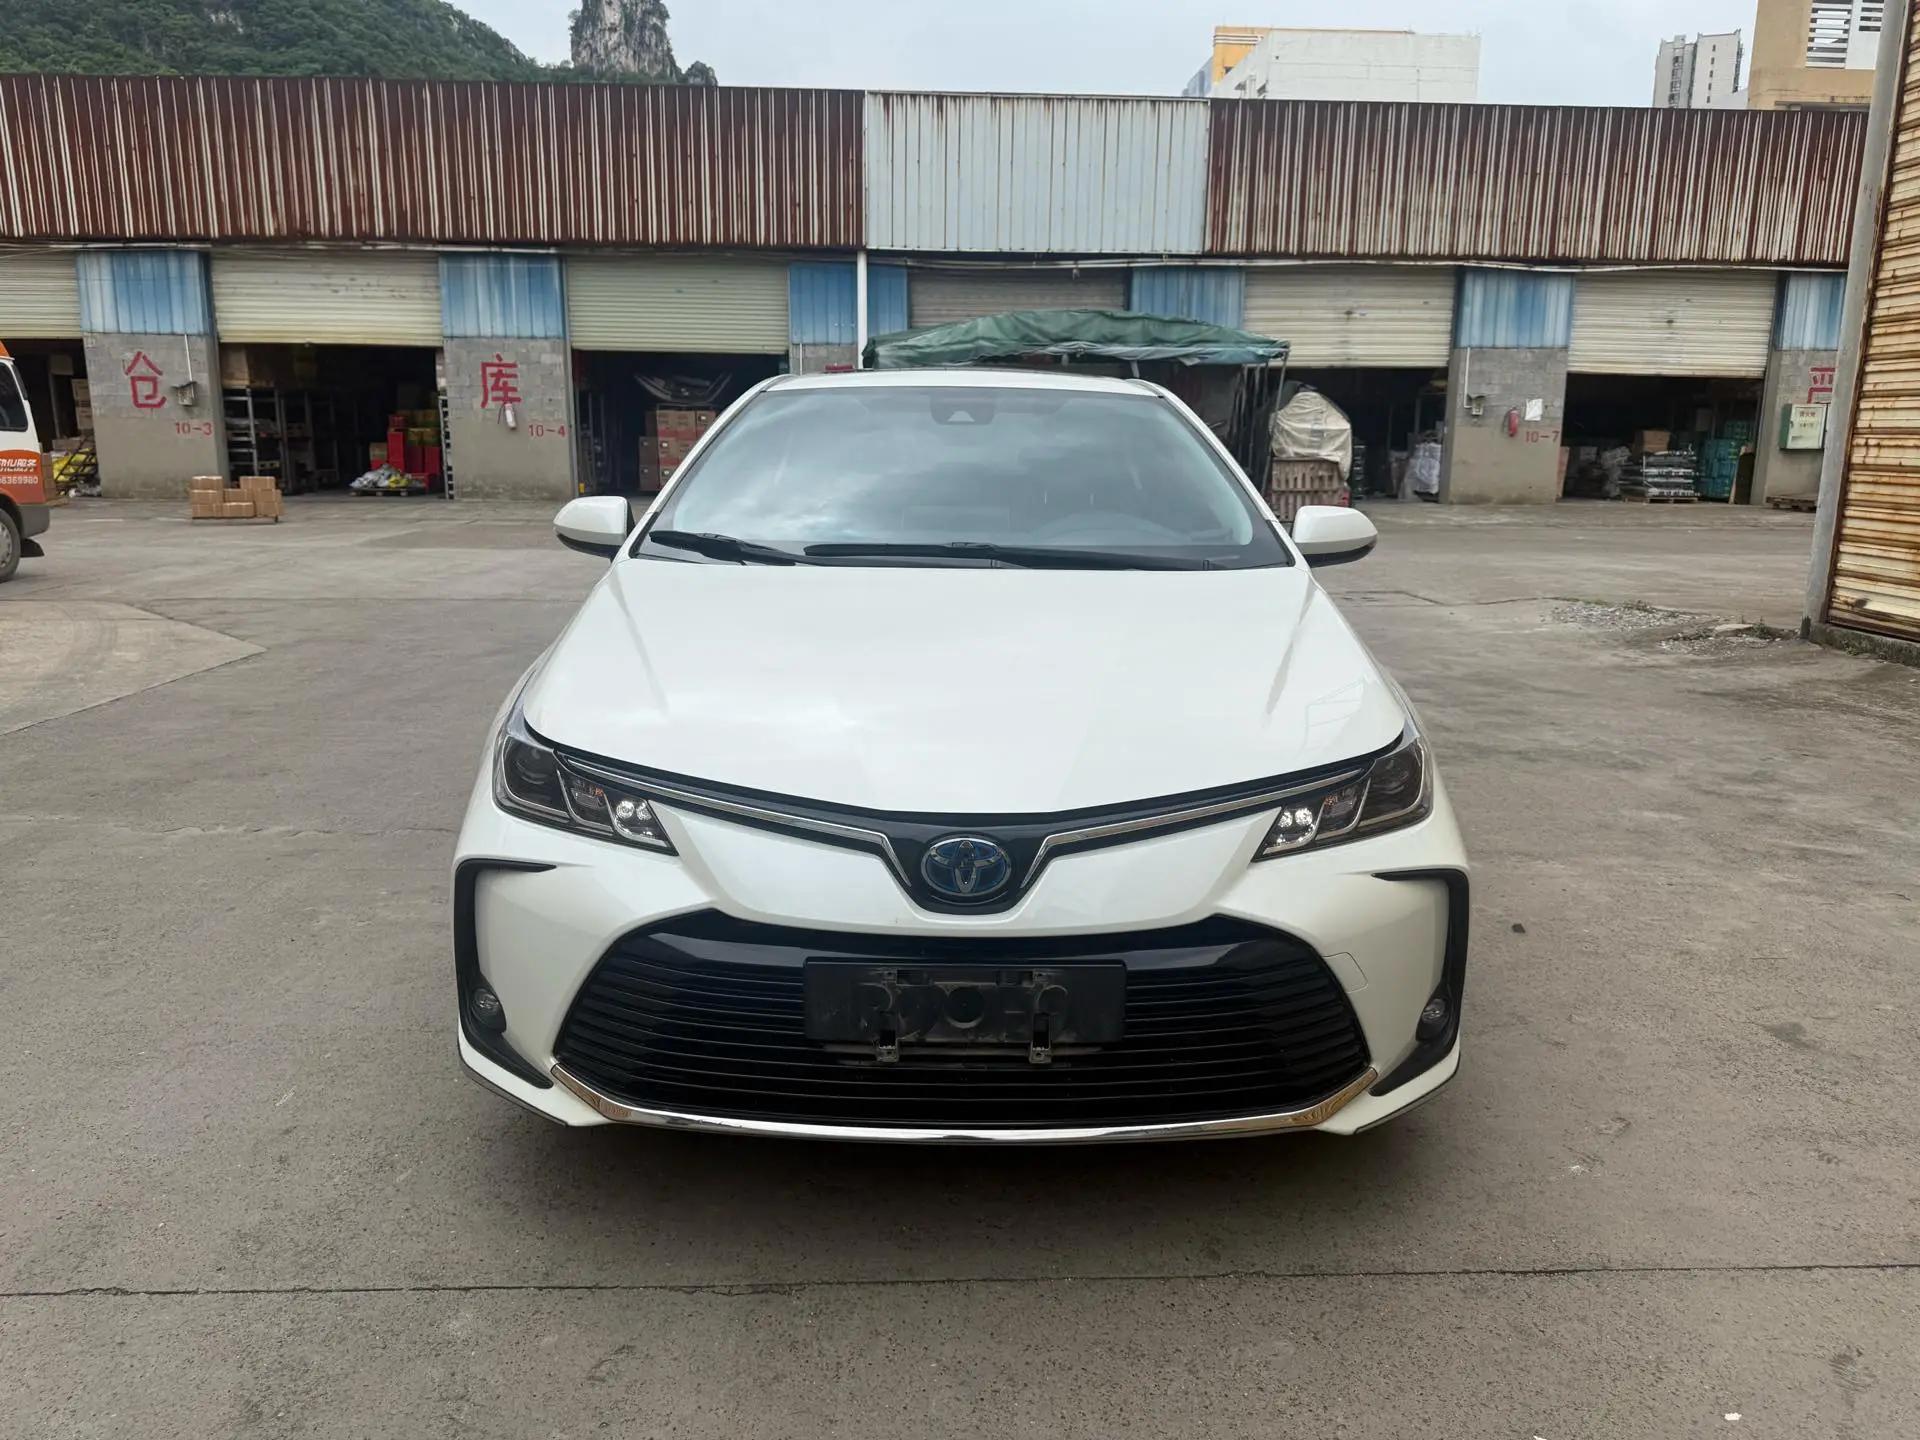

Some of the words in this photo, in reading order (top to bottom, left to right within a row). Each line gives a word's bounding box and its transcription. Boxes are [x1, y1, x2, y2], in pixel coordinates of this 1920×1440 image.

[125, 351, 167, 408] 仓
[480, 353, 522, 409] 库
[175, 422, 213, 436] 10-3
[528, 424, 567, 438] 10-4
[1526, 430, 1560, 443] 10-7
